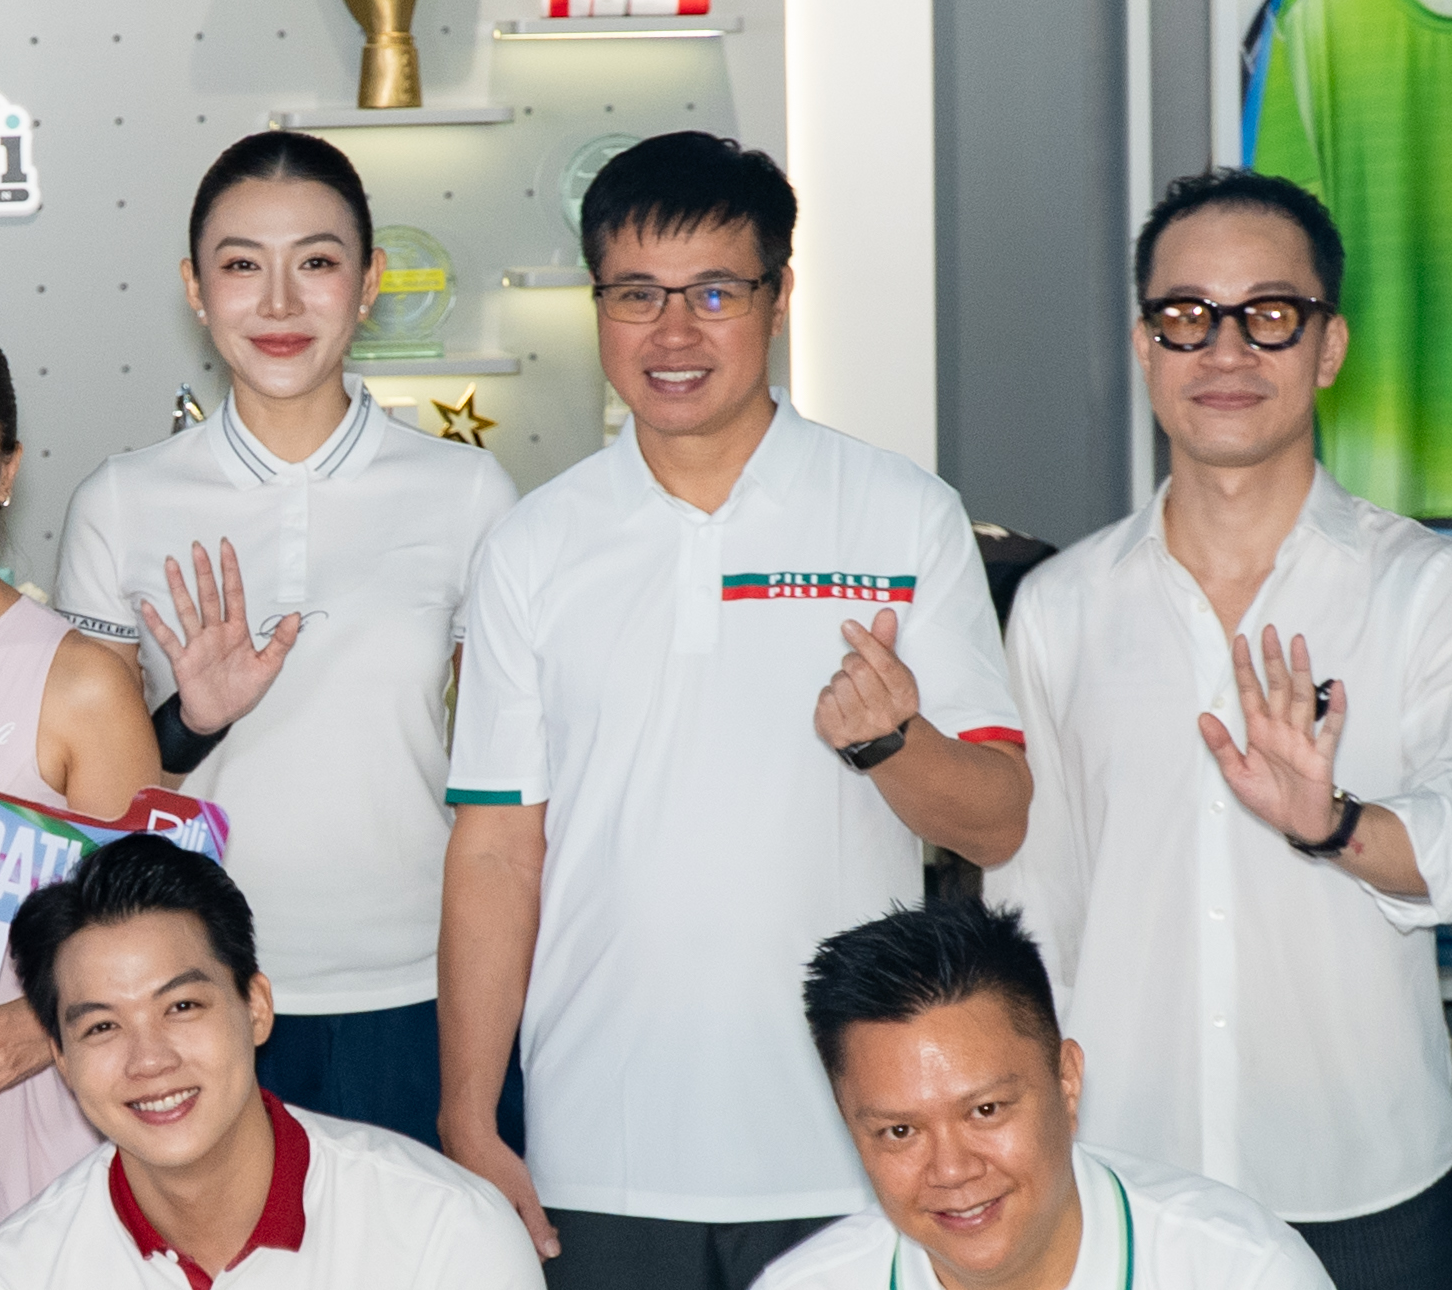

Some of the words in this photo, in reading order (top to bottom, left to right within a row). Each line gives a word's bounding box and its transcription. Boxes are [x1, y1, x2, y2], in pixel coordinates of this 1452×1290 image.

[769, 573, 819, 586] PILI
[831, 573, 890, 589] CLUB
[768, 585, 818, 598] PILI
